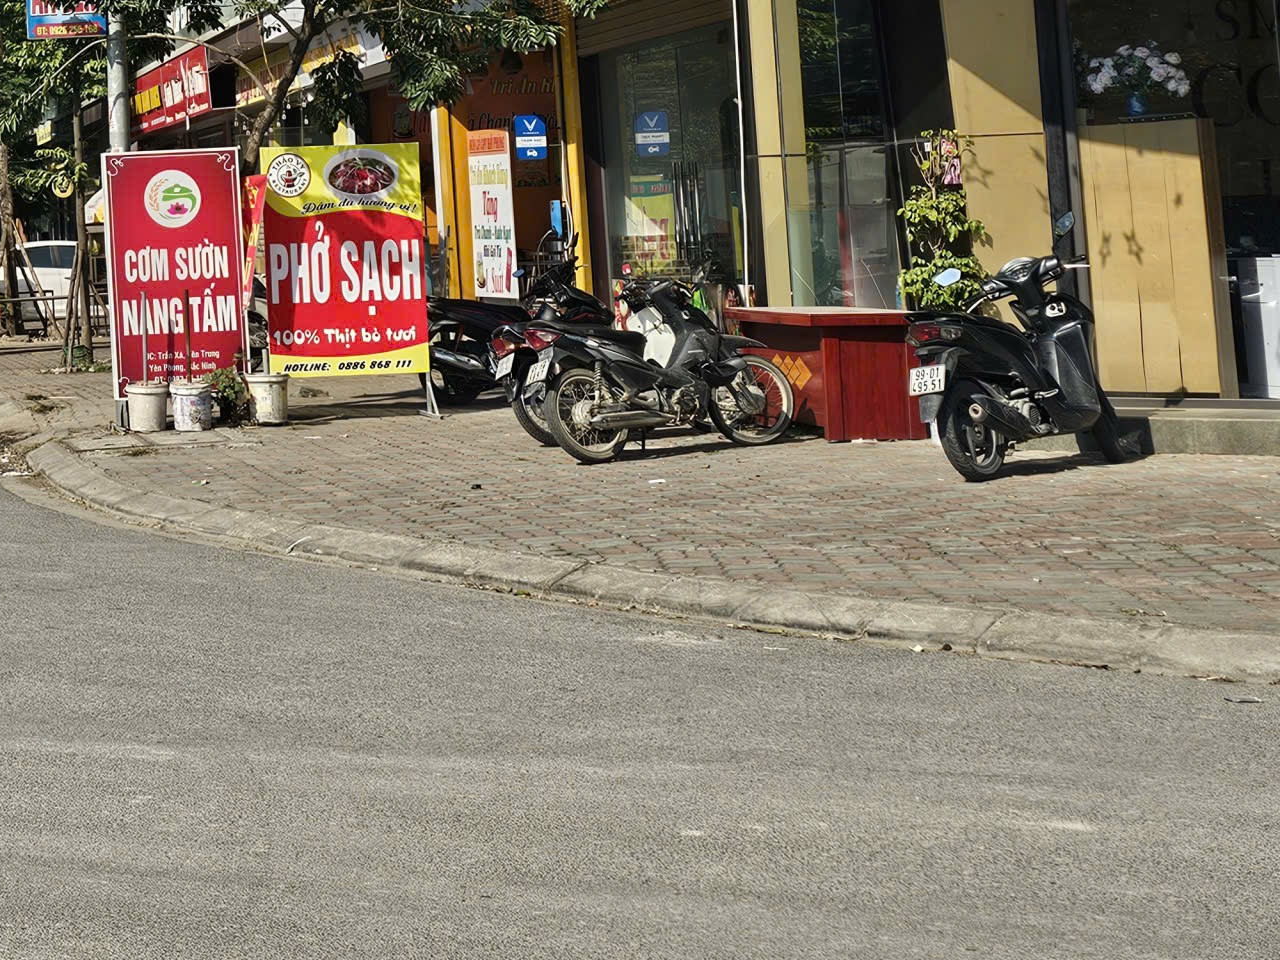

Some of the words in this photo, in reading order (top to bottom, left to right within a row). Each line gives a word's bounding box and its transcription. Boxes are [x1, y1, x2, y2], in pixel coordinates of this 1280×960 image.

[296, 159, 306, 170] VY
[271, 178, 308, 195] RESTAURANT
[124, 245, 170, 283] CƠM
[174, 238, 229, 280] SƯỜN
[270, 221, 330, 304] PHỞ
[340, 239, 422, 315] SẠCH
[189, 283, 238, 333] TẤM
[273, 329, 320, 345] 100%
[324, 328, 357, 349] Thịt
[361, 327, 381, 343] bò
[385, 325, 416, 341] tươi
[284, 363, 331, 372] HOTLINE:
[338, 361, 366, 370] 0886
[370, 360, 391, 369] 868
[396, 360, 412, 368] 111
